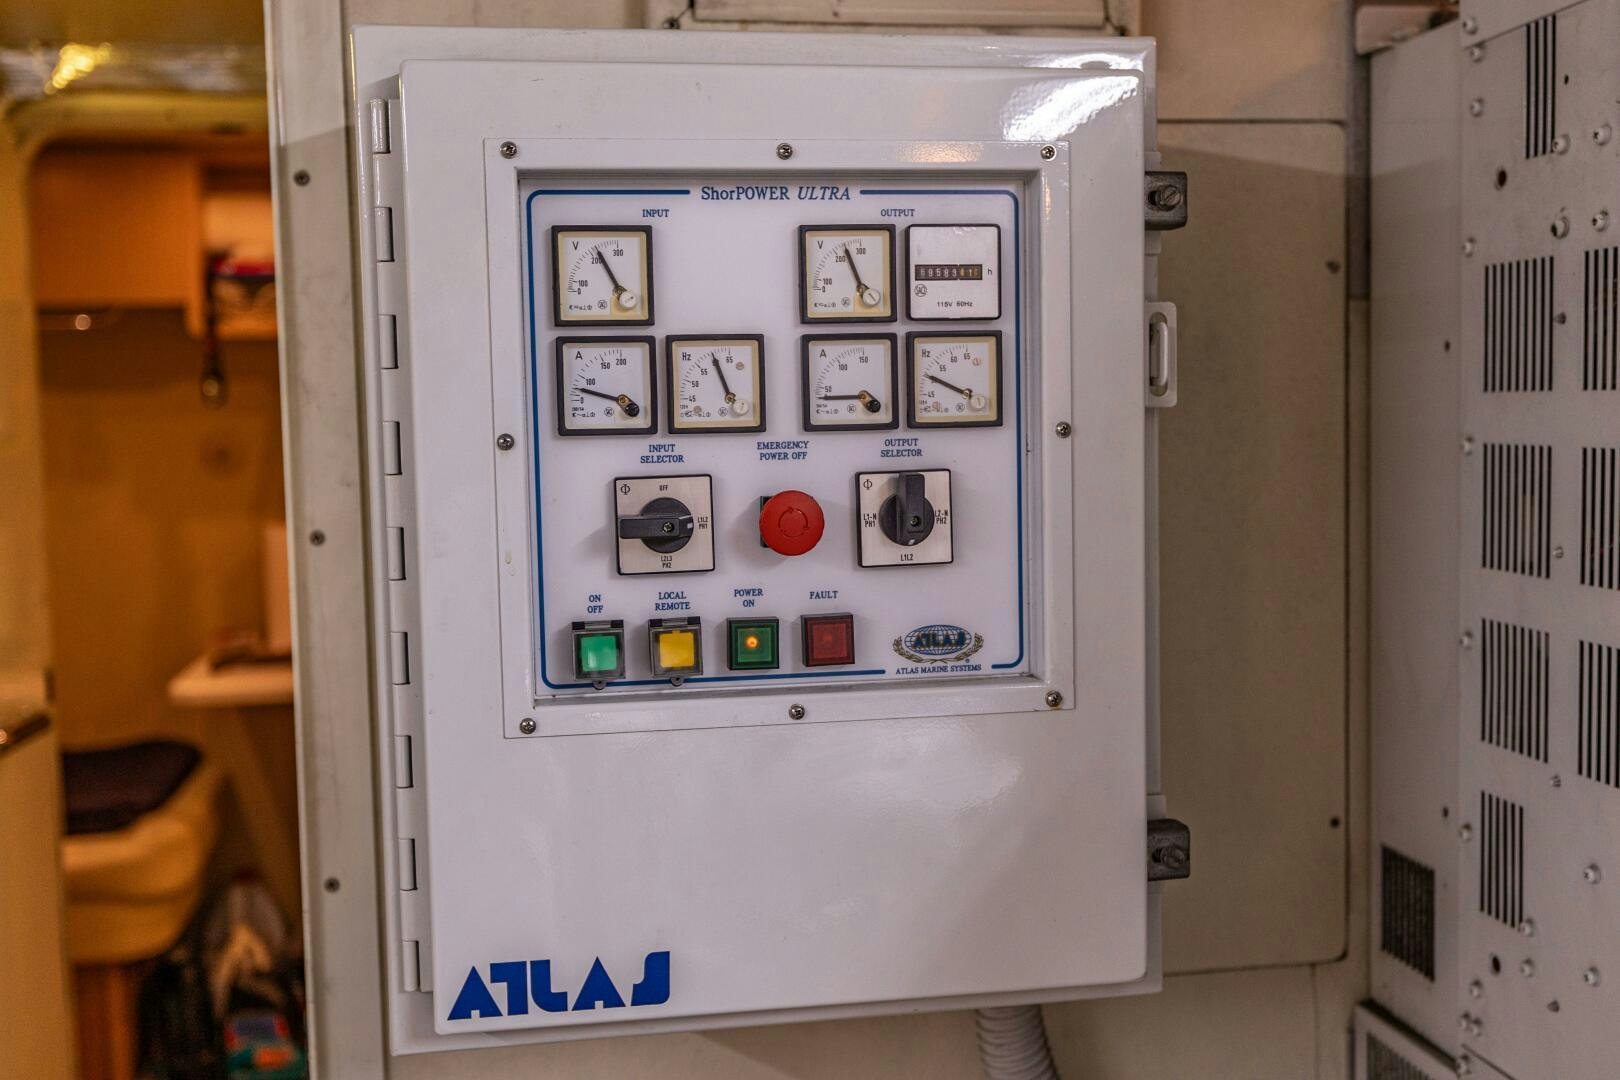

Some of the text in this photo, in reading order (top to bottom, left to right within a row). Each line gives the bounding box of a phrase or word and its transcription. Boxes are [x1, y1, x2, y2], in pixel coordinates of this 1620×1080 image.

[700, 186, 850, 200] ShorPOWER ULTRA
[642, 209, 669, 218] INPUT
[880, 208, 915, 217] OUTPUT
[572, 241, 579, 250] V
[817, 241, 823, 249] V
[575, 351, 583, 360] A
[682, 352, 691, 360] Hz
[820, 349, 826, 358] A
[921, 349, 930, 358] Hz
[757, 441, 809, 450] EMERGENCY
[884, 438, 918, 447] OUTPUT
[649, 444, 676, 452] INPUT
[760, 452, 807, 460] POWER OFF
[880, 449, 922, 458] SELECTOR
[640, 455, 684, 464] SELECTOR
[658, 592, 686, 600] LOCAL
[734, 589, 764, 597] POWER
[809, 591, 839, 599] FAULT
[588, 595, 601, 603] ON
[587, 605, 603, 614] OFF
[655, 602, 691, 611] REMOTE
[896, 664, 982, 675] ATLAS MARINE SYSTEMS
[447, 951, 670, 1020] ATLAS
